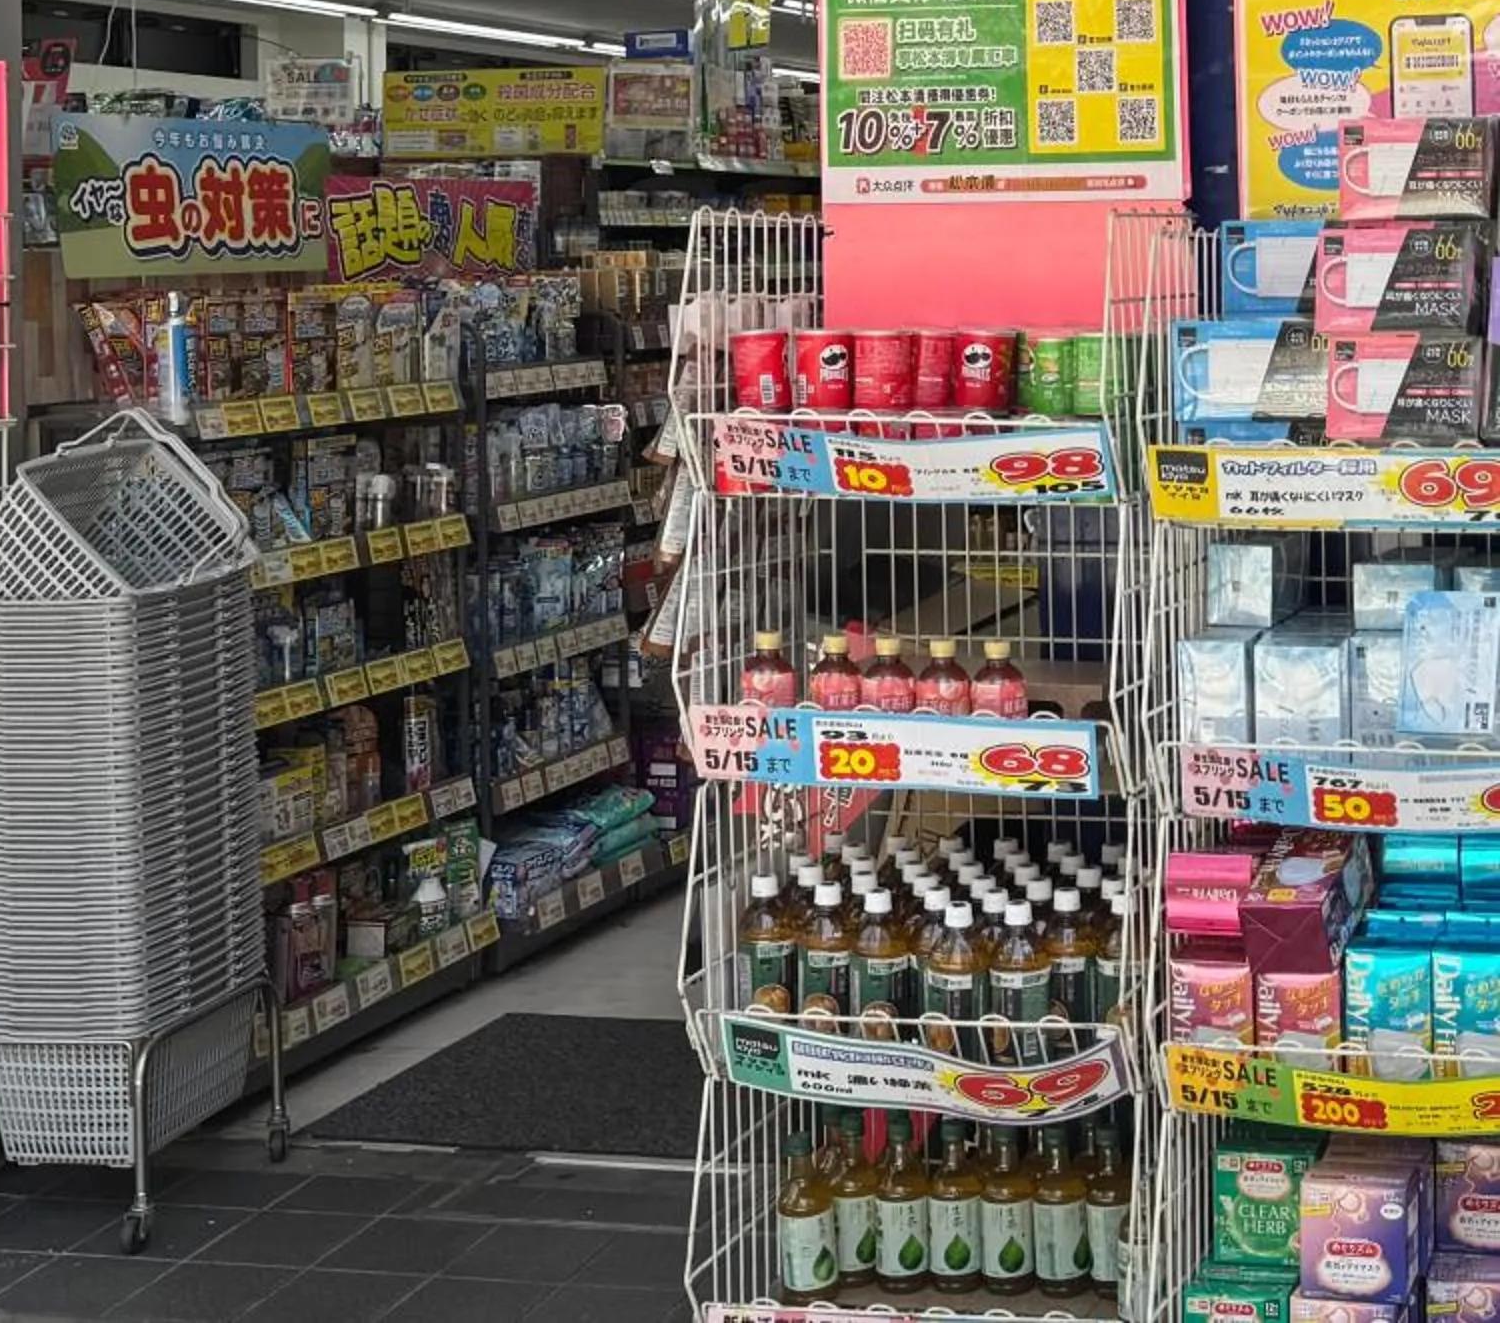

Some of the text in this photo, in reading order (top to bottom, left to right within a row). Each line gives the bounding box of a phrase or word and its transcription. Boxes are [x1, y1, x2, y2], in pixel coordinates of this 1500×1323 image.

[1415, 302, 1461, 316] MASK
[1426, 409, 1473, 424] MASK
[765, 430, 813, 454] SALE
[731, 454, 782, 478] 5/15
[843, 463, 888, 490] 10
[990, 446, 1105, 484] 98
[1034, 480, 1105, 494] 105
[746, 716, 797, 740] SALE
[705, 749, 791, 773] 5/15 まで
[830, 749, 875, 775] 20
[980, 743, 1090, 778] 68
[1235, 757, 1290, 784] SALE
[1313, 776, 1364, 789] 767
[1193, 786, 1285, 813] 5/15 まで
[1323, 794, 1371, 820] 50
[1223, 1060, 1277, 1088] SALE
[1181, 1084, 1238, 1110] 5/15
[1312, 1098, 1361, 1125] 200
[1238, 1204, 1291, 1220] CLEAR
[1243, 1220, 1287, 1235] HERB
